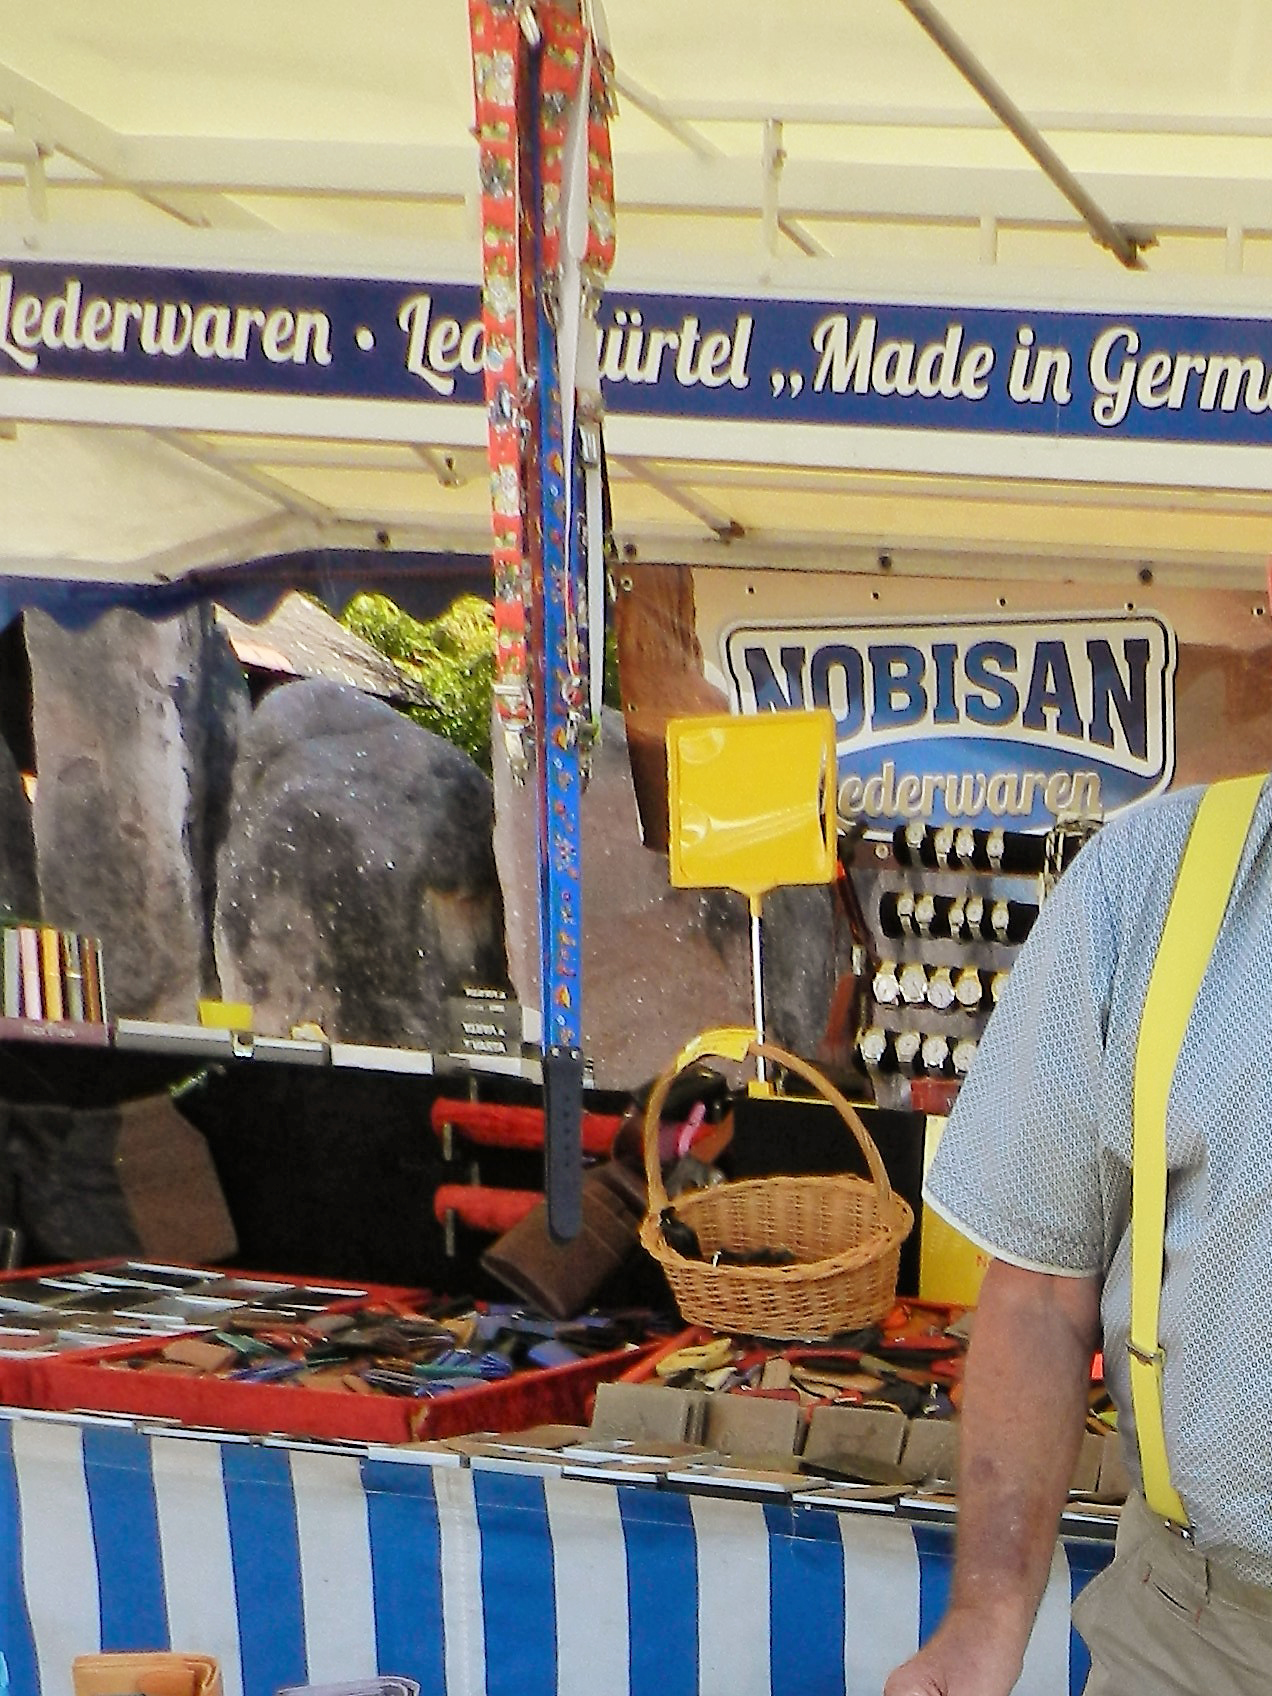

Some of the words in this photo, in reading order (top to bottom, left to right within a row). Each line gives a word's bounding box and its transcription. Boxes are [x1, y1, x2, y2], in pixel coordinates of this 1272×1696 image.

[1008, 327, 1072, 405] in
[744, 639, 1151, 761] NOBISAN
[838, 762, 1103, 818] ederwaren
